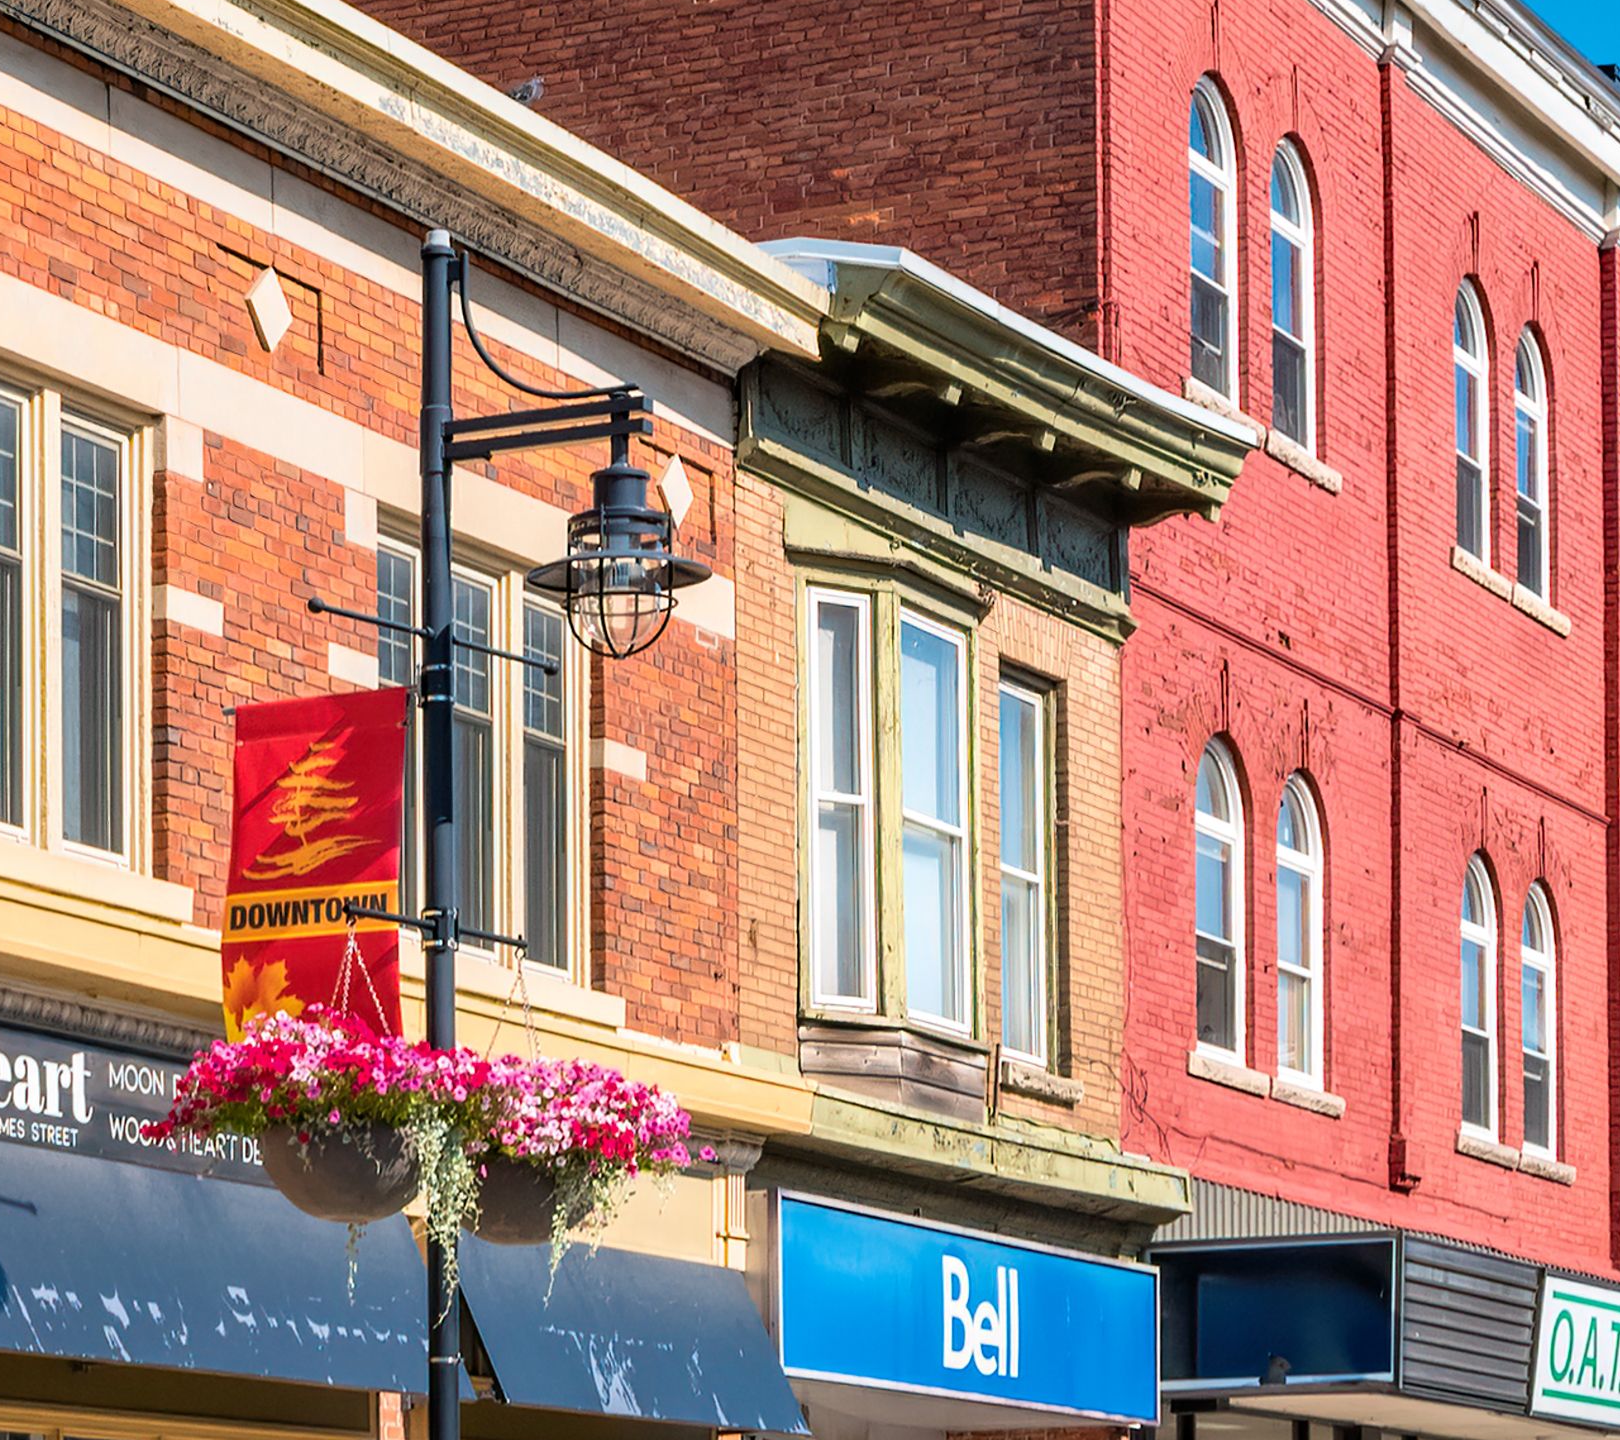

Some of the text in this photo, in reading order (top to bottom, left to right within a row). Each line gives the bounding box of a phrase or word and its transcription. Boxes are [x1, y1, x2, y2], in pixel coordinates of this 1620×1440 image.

[109, 1061, 165, 1097] MOON
[31, 1122, 79, 1148] STREET
[943, 1253, 1020, 1378] Bell
